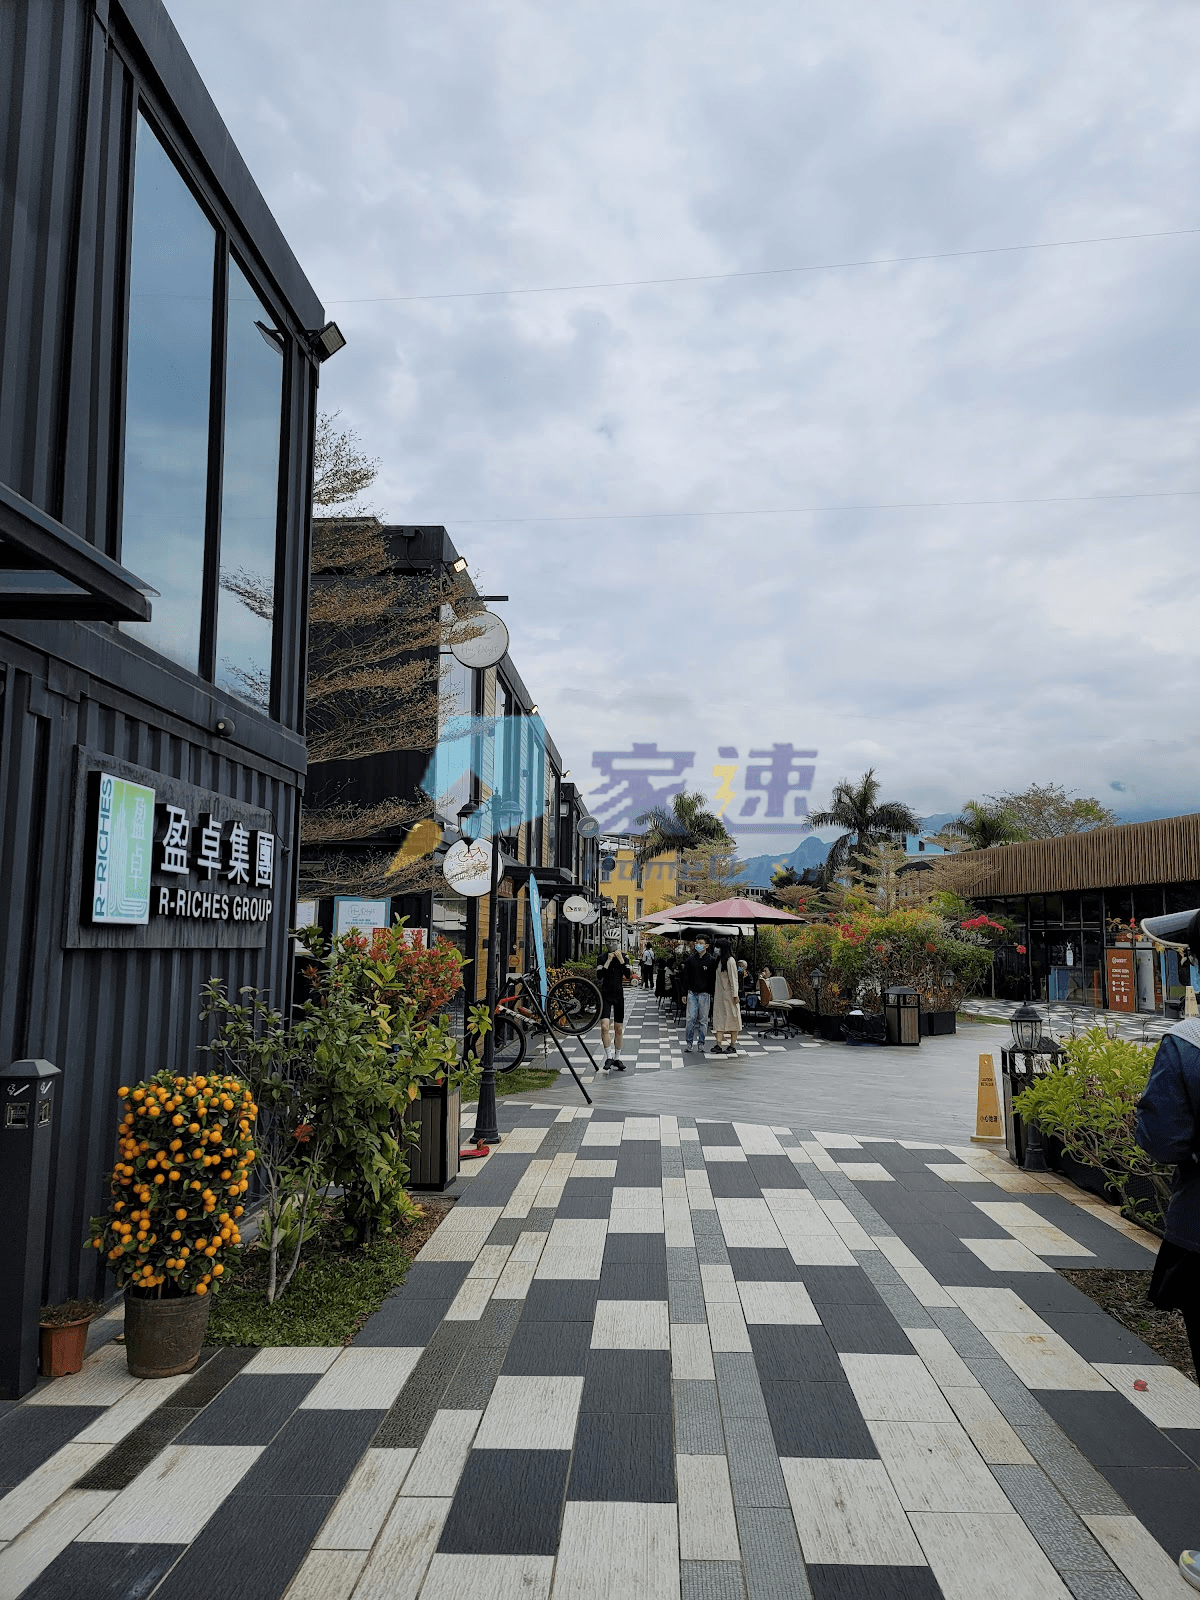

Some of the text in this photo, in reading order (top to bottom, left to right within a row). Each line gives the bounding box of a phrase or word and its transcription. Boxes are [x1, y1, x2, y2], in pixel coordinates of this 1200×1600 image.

[94, 778, 112, 917] R-RICHES
[128, 797, 147, 890] 盈卓
[161, 804, 275, 889] 盈卓集團
[158, 886, 230, 921] R-RICHES
[232, 895, 273, 922] GROUP
